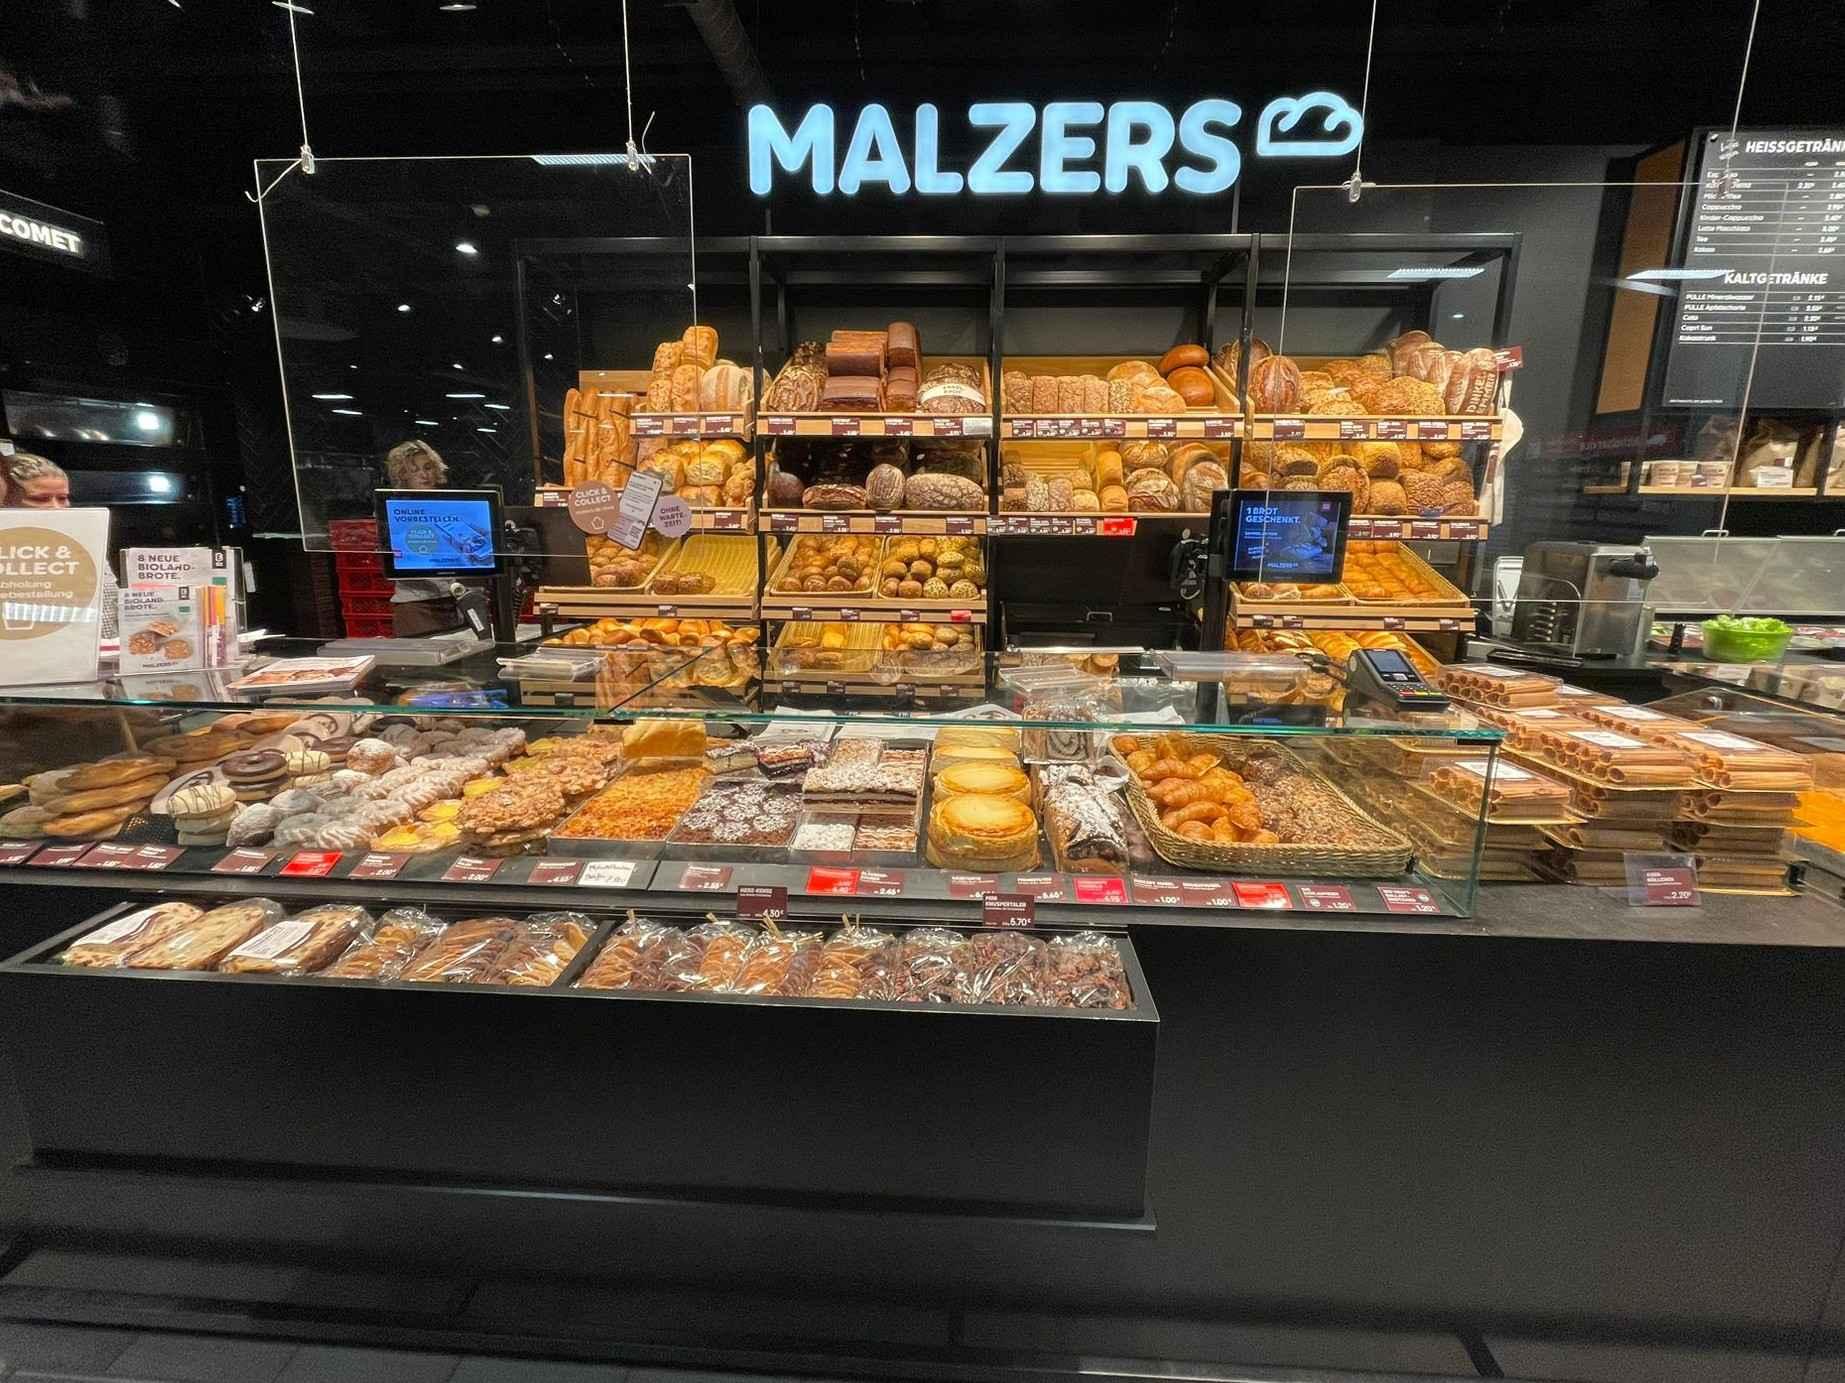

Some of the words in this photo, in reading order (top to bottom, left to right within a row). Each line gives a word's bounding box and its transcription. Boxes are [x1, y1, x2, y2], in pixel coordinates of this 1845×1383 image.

[747, 99, 1243, 195] MALZERS
[1724, 272, 1829, 285] KALTGETRÄNKE
[576, 488, 602, 499] CLICK
[574, 495, 611, 507] COLLECT
[393, 508, 425, 516] ONLINE
[1253, 507, 1277, 515] BROT
[55, 545, 72, 559] &
[137, 554, 145, 562] 8
[148, 554, 180, 562] NEUE
